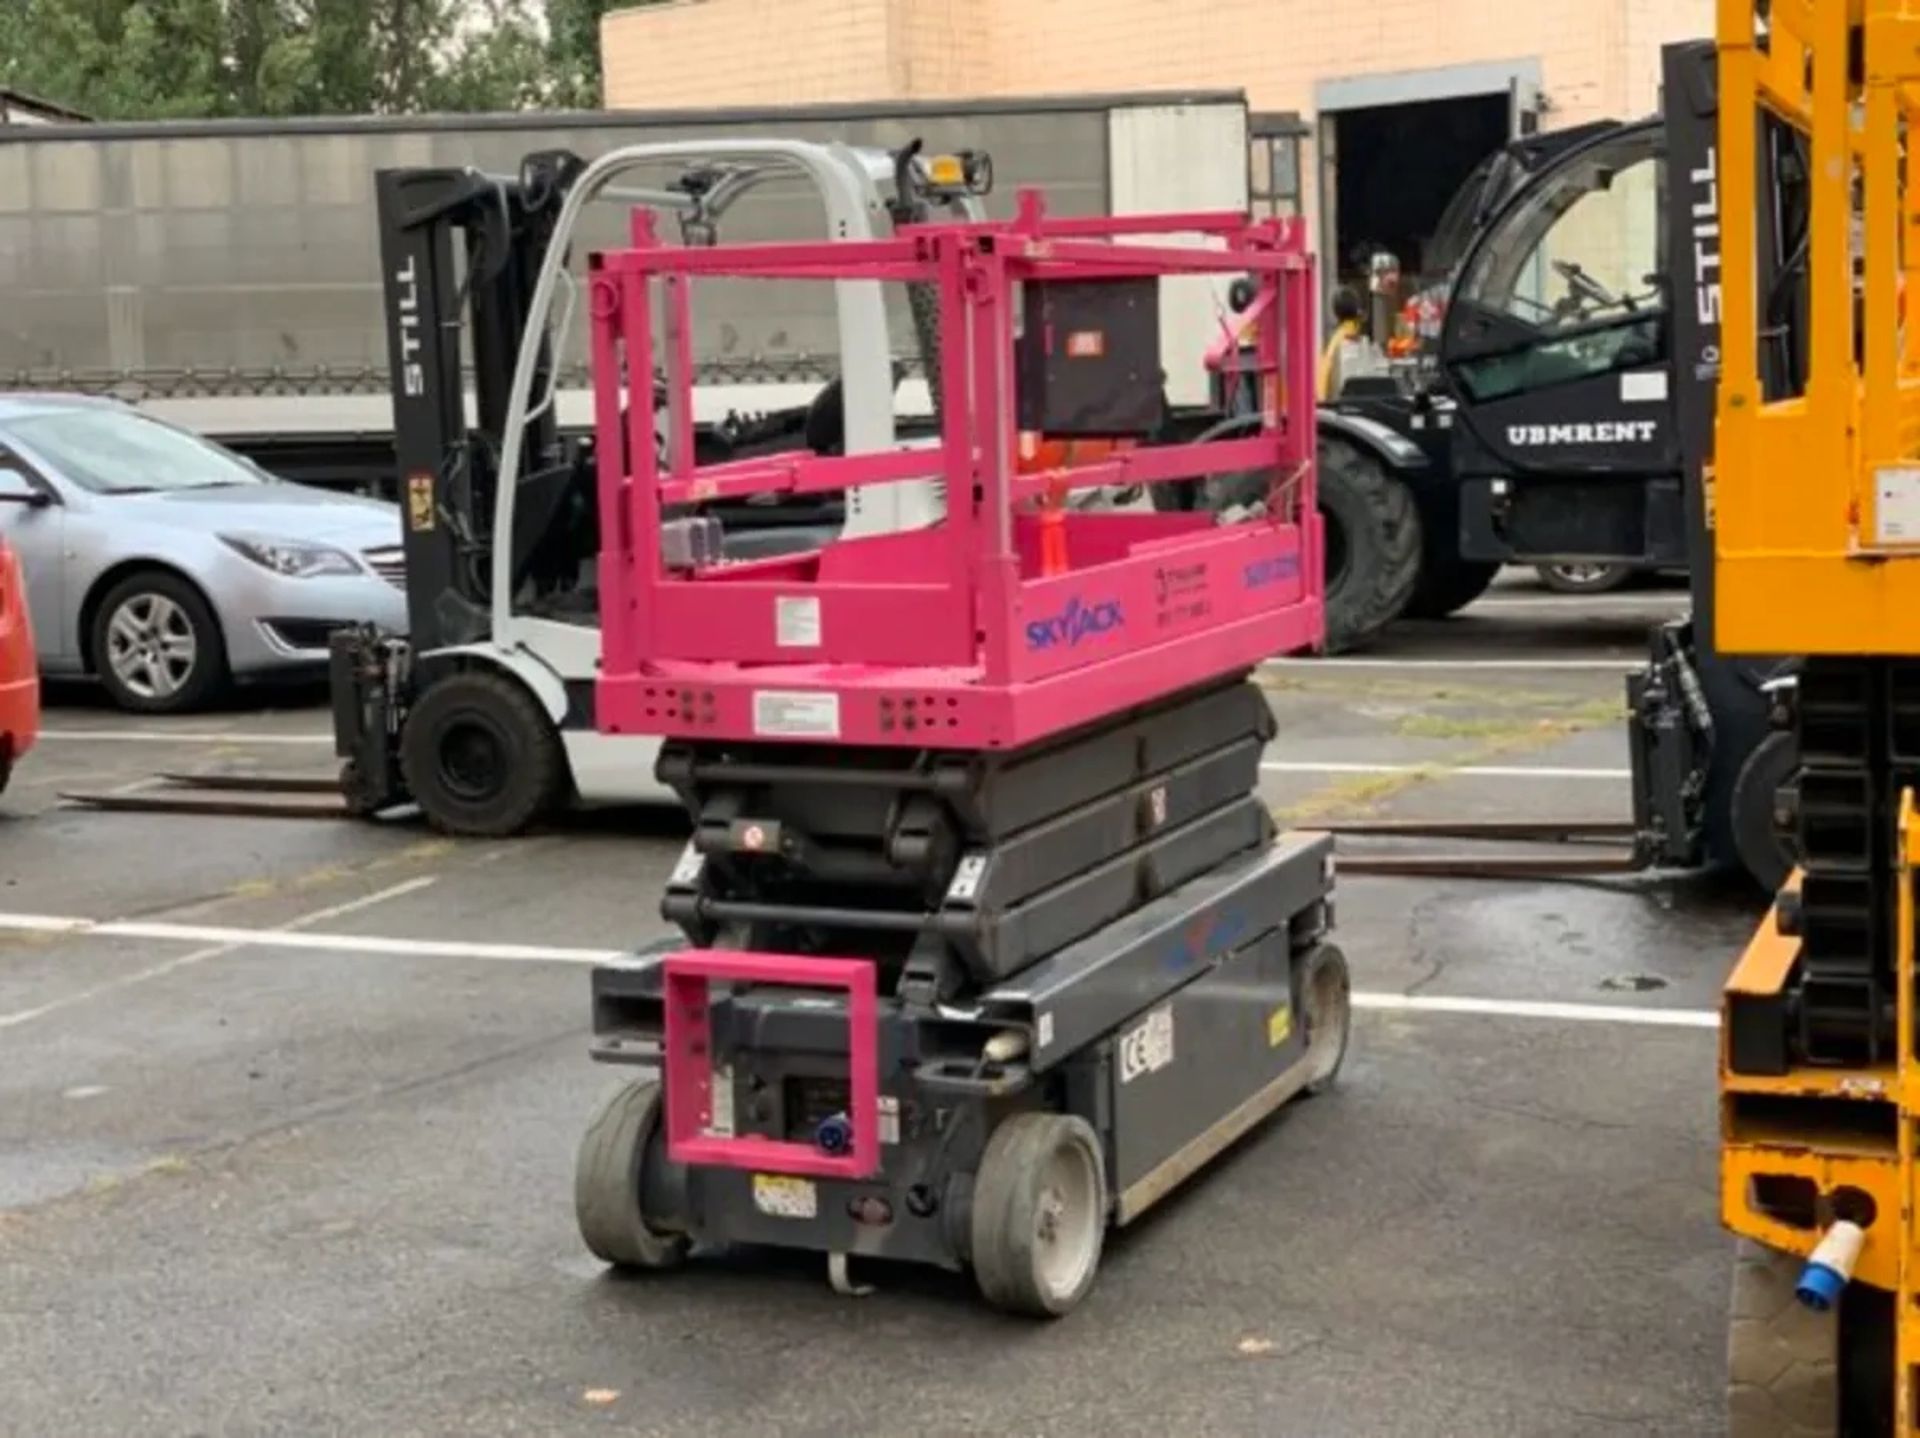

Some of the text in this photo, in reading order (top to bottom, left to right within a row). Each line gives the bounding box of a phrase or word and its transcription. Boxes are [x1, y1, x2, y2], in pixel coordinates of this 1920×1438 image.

[1690, 146, 1722, 325] STILL
[396, 254, 424, 396] STILL
[1508, 420, 1656, 445] UBMRENT
[1025, 597, 1124, 648] SKYJACK
